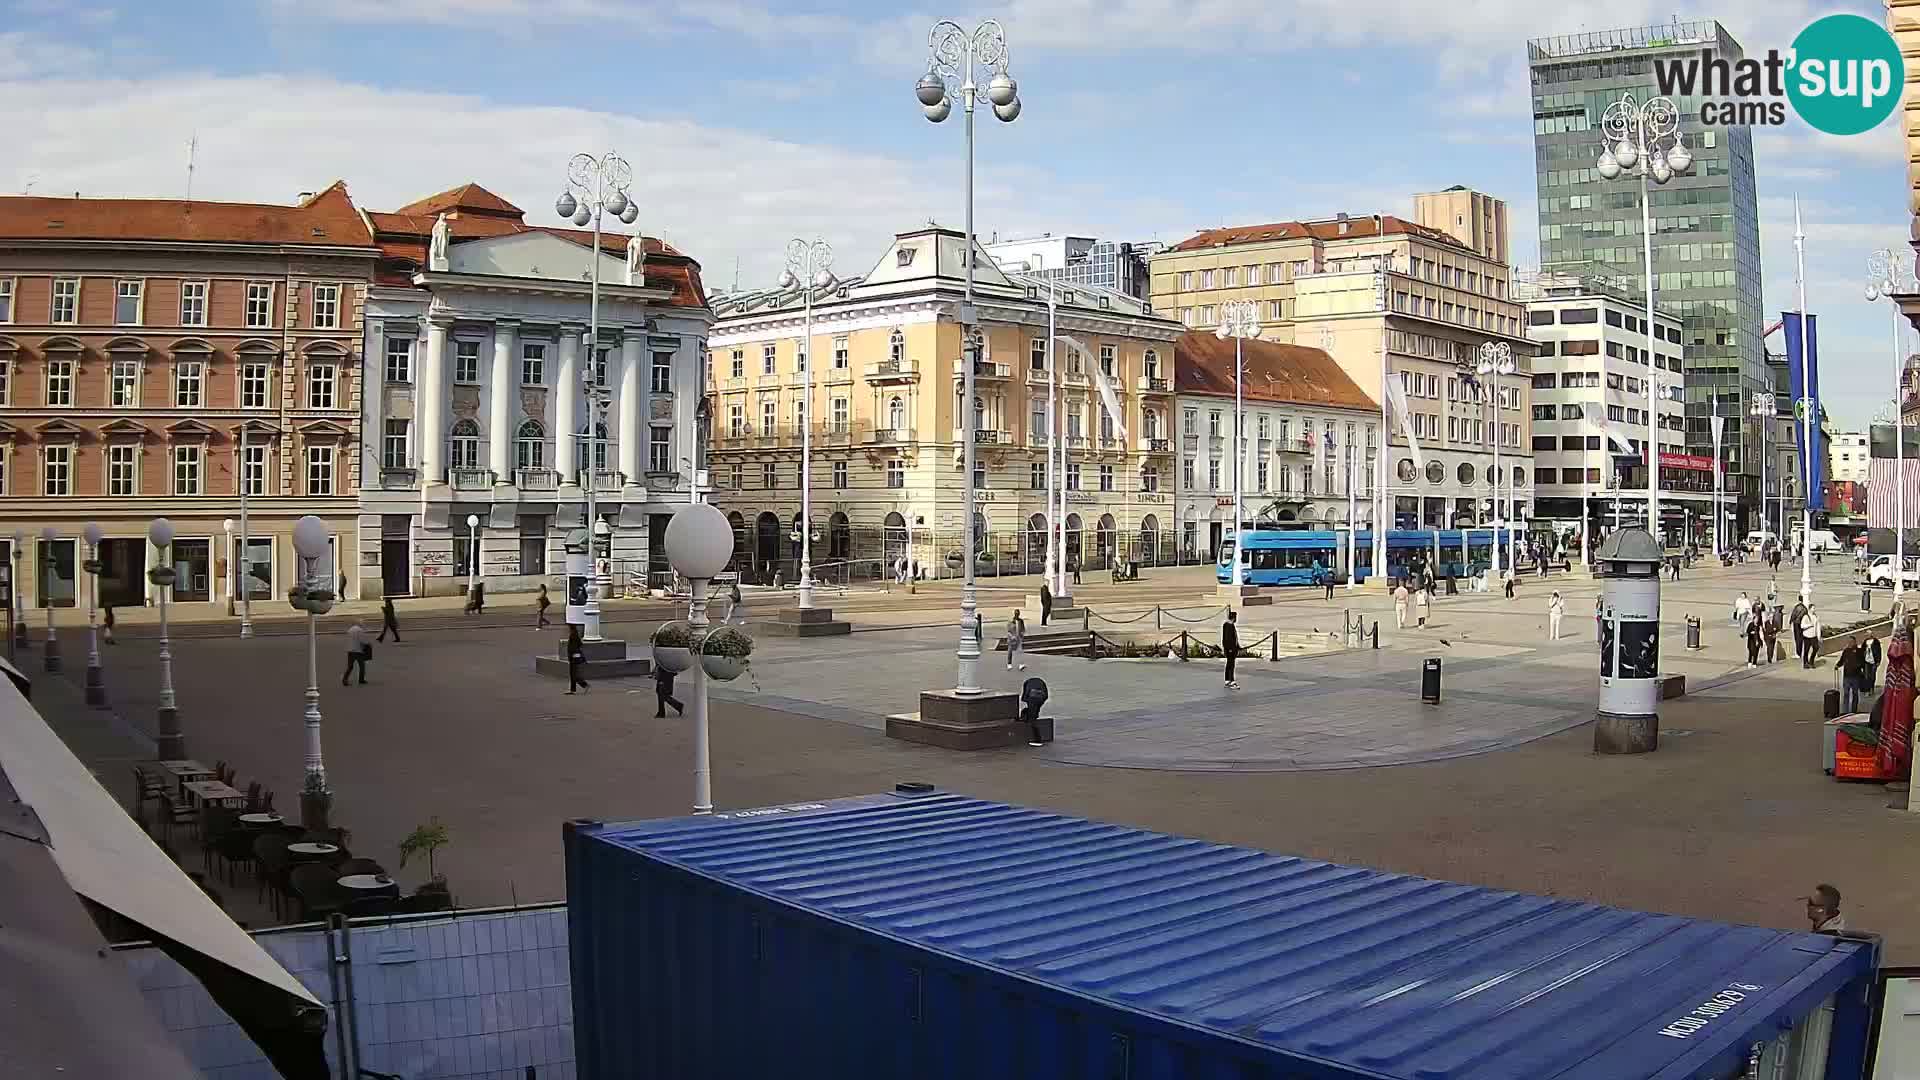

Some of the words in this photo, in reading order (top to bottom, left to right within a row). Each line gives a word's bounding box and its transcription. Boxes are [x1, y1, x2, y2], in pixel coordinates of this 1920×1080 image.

[961, 491, 996, 501] SNGER
[1657, 1016, 1709, 1039] MCDU
[1692, 990, 1747, 1018] 300629
